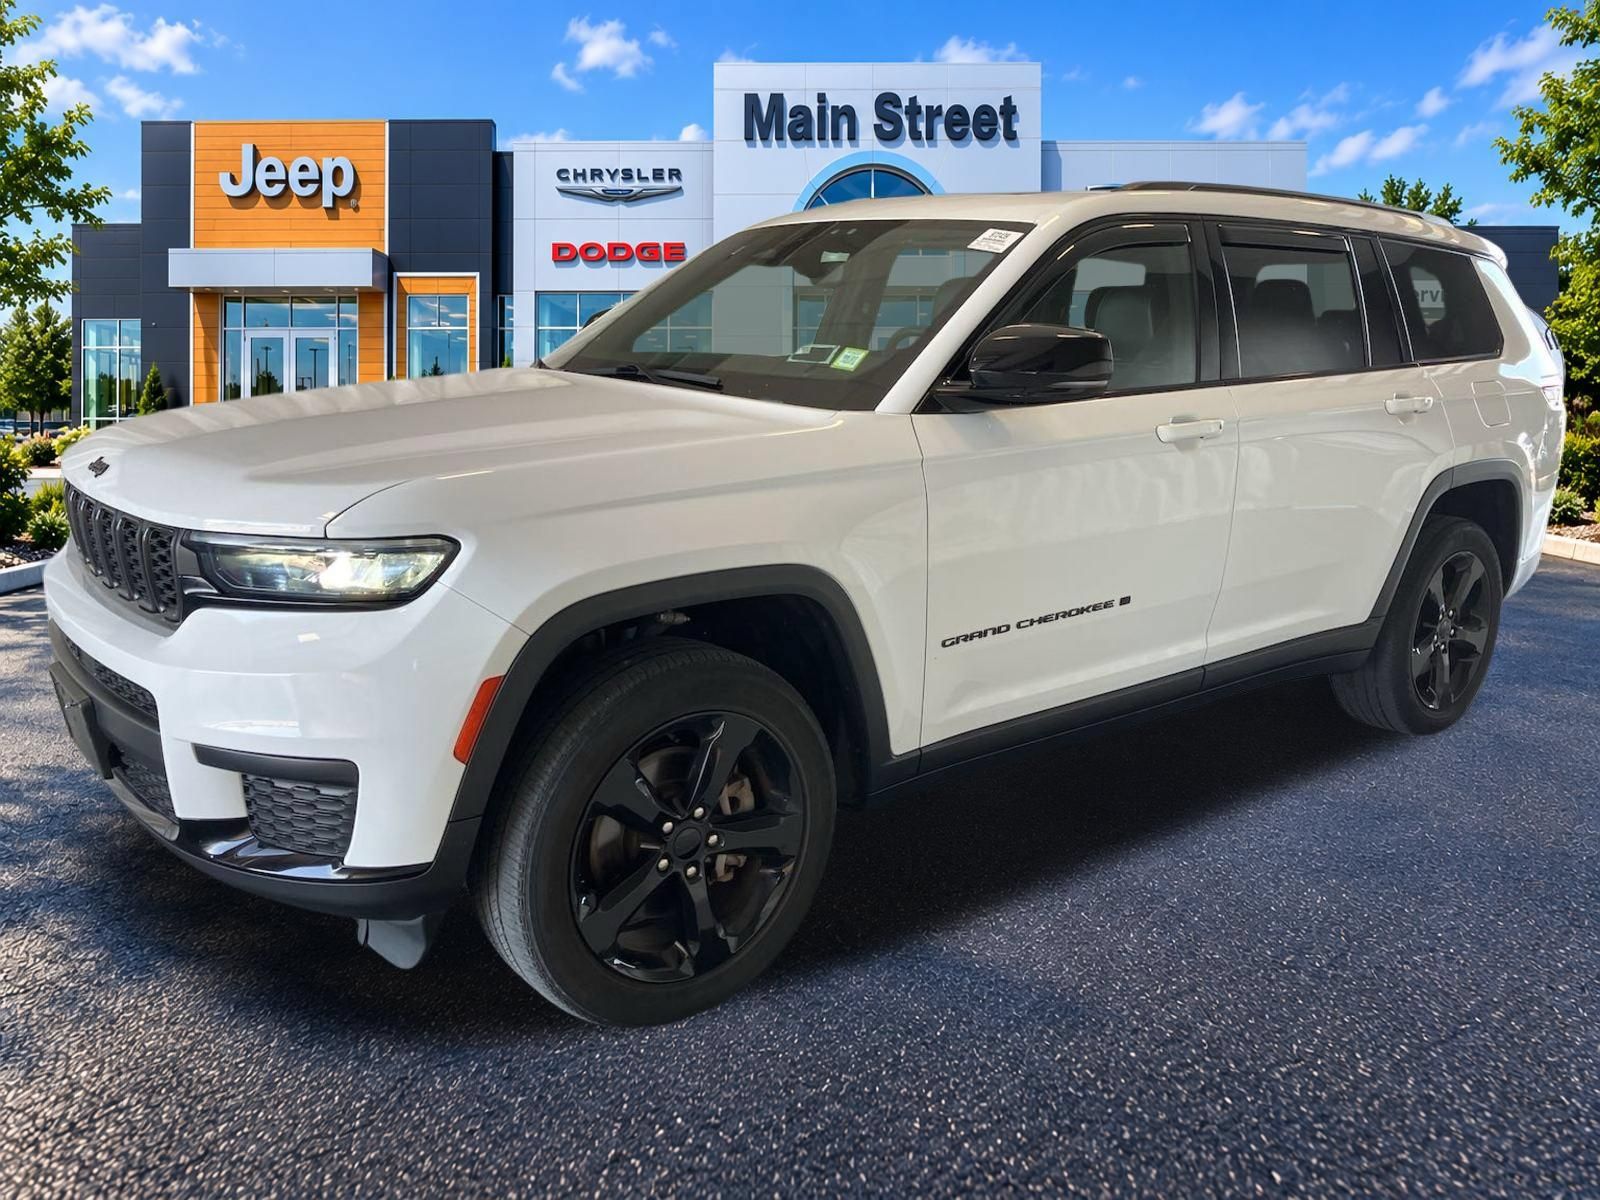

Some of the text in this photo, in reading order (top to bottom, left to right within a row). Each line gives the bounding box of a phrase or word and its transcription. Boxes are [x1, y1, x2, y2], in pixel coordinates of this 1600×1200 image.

[744, 91, 1018, 141] Main Street
[219, 143, 354, 208] Jeep
[556, 168, 683, 182] CHRYSLER
[551, 242, 687, 263] DODGE
[941, 599, 1116, 648] GRAND CHEROKEE
